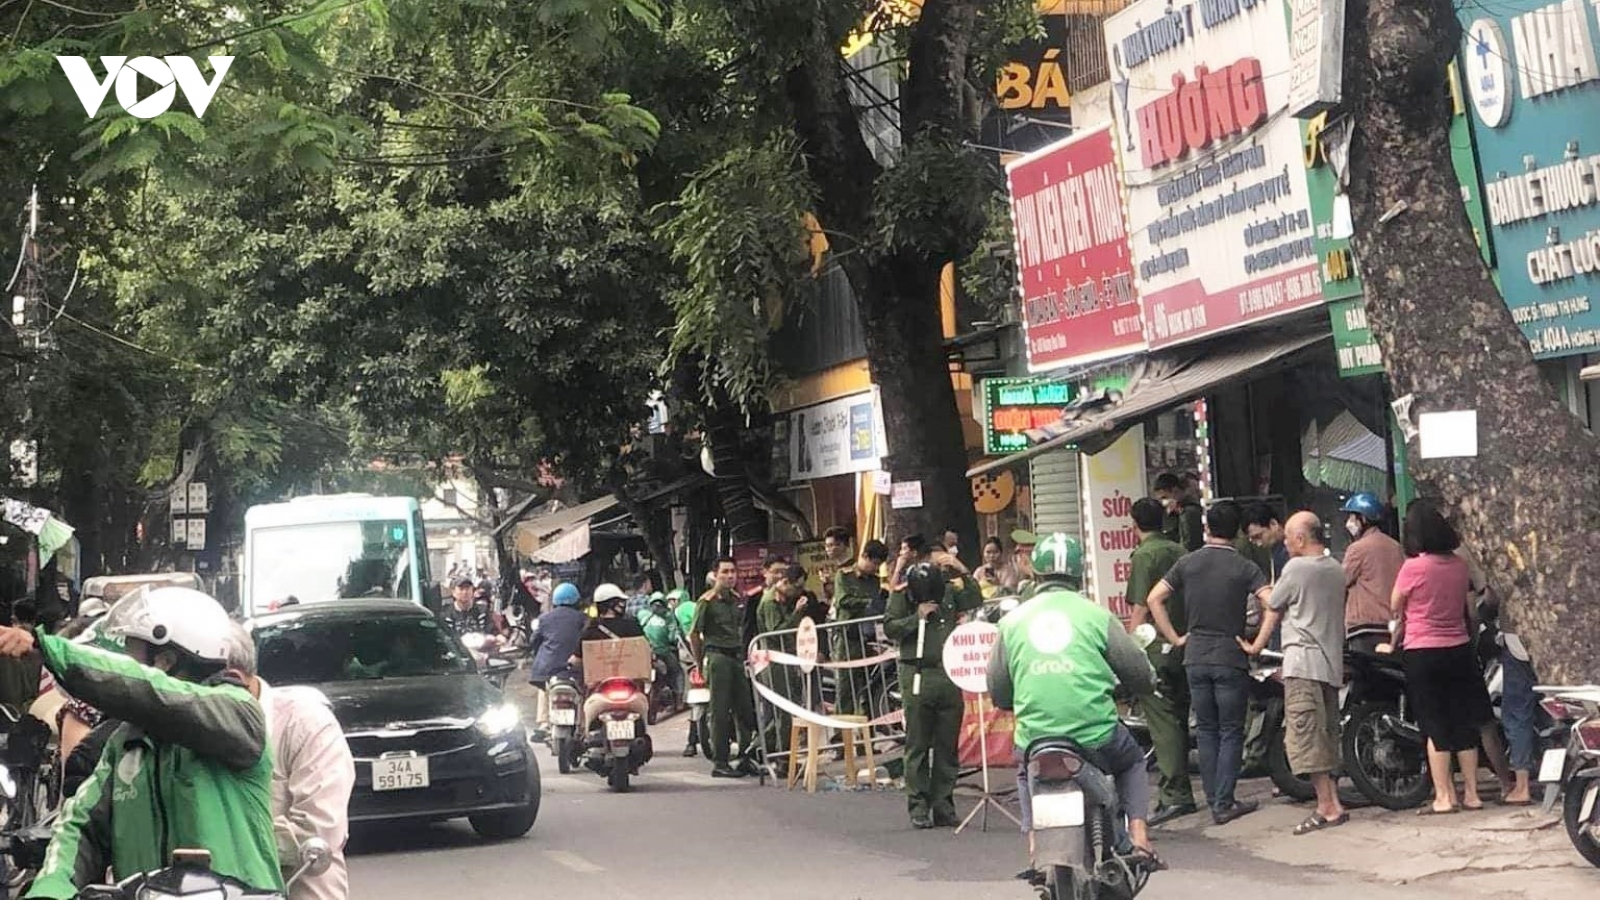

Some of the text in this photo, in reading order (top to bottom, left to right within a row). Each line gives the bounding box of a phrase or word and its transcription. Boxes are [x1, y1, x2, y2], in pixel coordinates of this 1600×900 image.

[952, 634, 975, 647] KHU
[388, 760, 412, 774] 34A
[379, 773, 423, 788] 591.75
